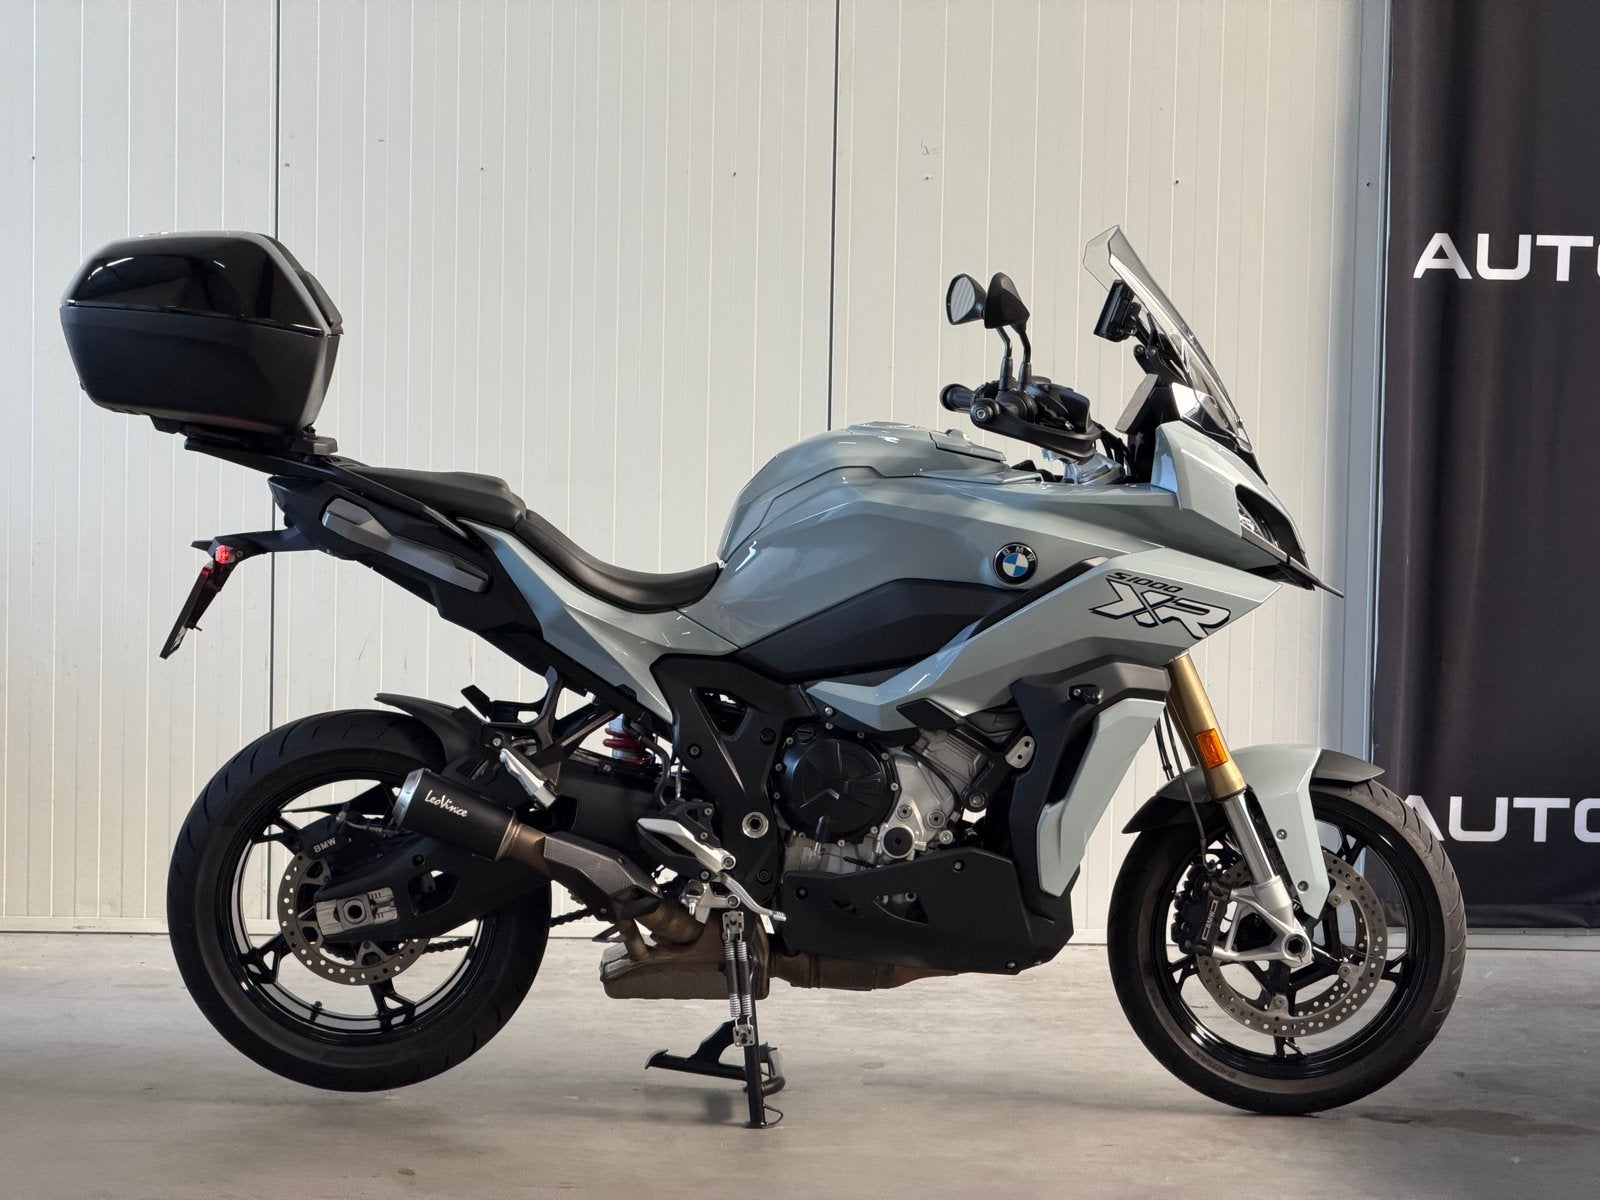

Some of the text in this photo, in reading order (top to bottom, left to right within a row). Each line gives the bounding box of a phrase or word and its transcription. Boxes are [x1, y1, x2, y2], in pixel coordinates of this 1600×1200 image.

[1413, 232, 1600, 282] AUT
[1107, 571, 1184, 593] S1000
[1089, 577, 1232, 640] XR
[425, 790, 468, 817] LeoVince
[313, 836, 336, 853] BMW
[1204, 910, 1216, 929] BMW
